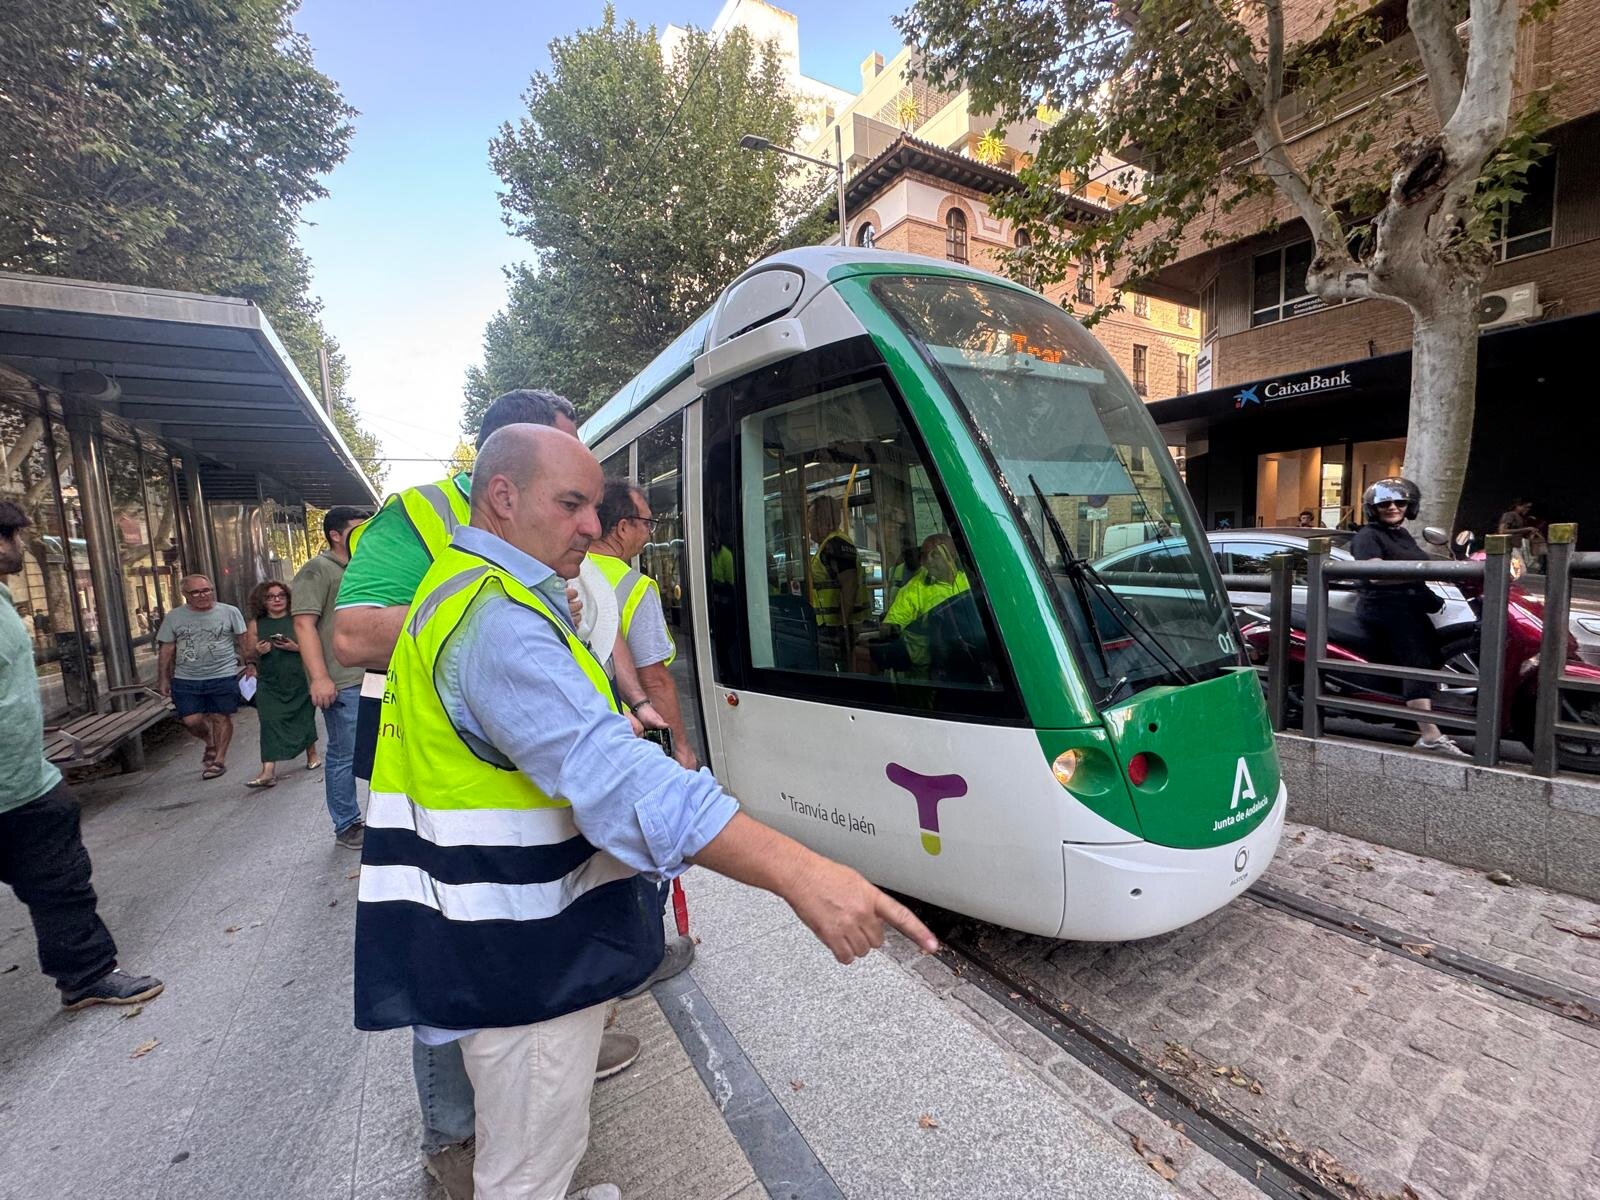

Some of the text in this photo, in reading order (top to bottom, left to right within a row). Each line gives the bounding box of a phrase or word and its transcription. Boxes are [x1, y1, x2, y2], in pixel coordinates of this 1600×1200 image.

[1264, 370, 1351, 398] CaixaBank
[1217, 631, 1236, 654] 01
[788, 795, 876, 836] Tranvía de Jaén
[1212, 795, 1269, 832] Junta de Andalucía
